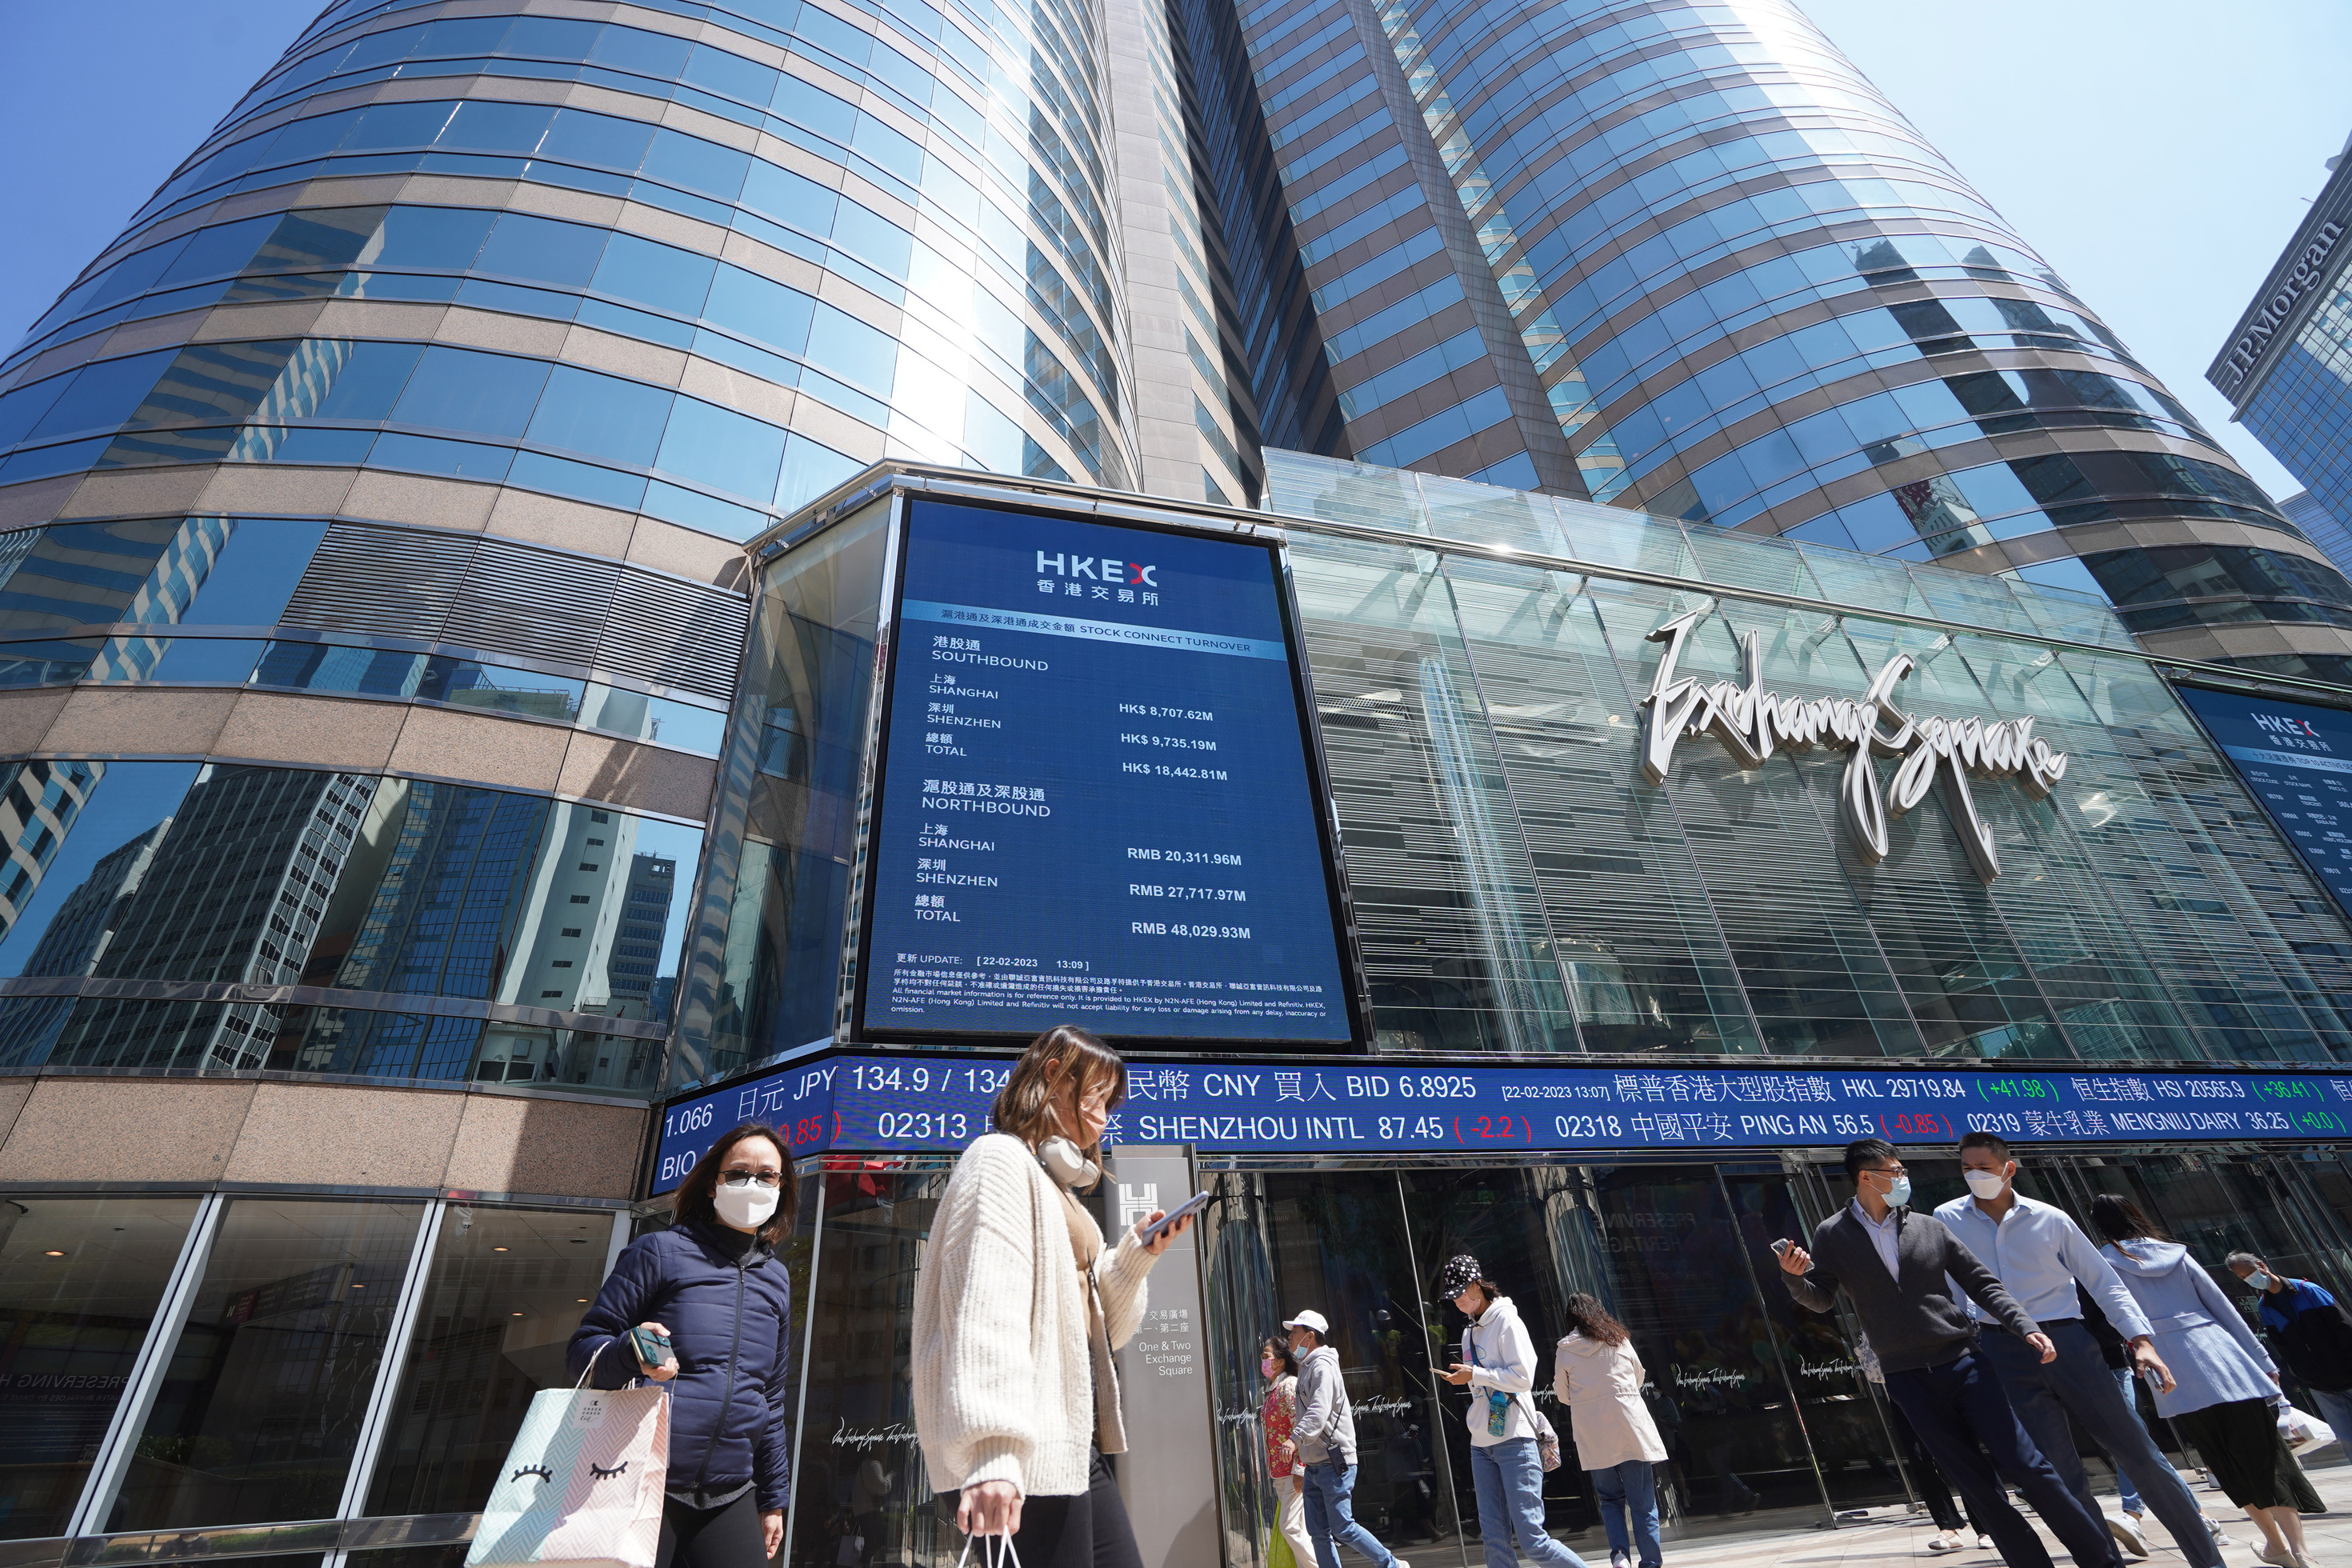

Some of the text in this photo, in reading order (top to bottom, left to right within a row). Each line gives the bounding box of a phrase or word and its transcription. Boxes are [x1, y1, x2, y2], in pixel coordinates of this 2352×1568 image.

[2226, 221, 2344, 386] J.P.Morgan
[1037, 550, 1158, 587] HKEX
[1037, 579, 1159, 606] 香港交易所
[932, 635, 981, 655] 港股通
[1080, 625, 1251, 653] STOCK CONNECT TURNOVER
[932, 650, 1049, 671] SOUTHBOUND
[930, 673, 957, 686] 上海
[929, 685, 998, 699] SHANGHAI
[927, 702, 954, 714] 深圳
[1119, 703, 1214, 722] HK$ 8,707.62M
[926, 714, 1001, 729] SHENZHEN
[2250, 713, 2321, 737] HKEX
[925, 731, 954, 745] 總額
[1121, 733, 1217, 751] HK$ 9,735.19M
[2269, 734, 2333, 752] 香港交易所
[925, 744, 967, 757] TOTAL
[1122, 762, 1228, 781] HK$ 18,442.81M
[922, 778, 1046, 805] 滬股通及深股通
[922, 794, 1050, 818] NORTHBOUND
[919, 822, 949, 836] 上海
[918, 837, 994, 851] SHANGHAI
[917, 858, 946, 872] 深圳
[1127, 847, 1242, 866] RMB 20,311.96M
[916, 872, 998, 887] SHENZHEN
[914, 894, 946, 908] 總額
[1130, 883, 1246, 902] RMB 27,717.97M
[914, 909, 961, 922] TOTAL
[1131, 922, 1251, 939] RMB 48,029.93M
[896, 953, 918, 963] 更新
[920, 954, 1083, 970] UPDATE: 22-02-2023 13:09
[793, 1066, 838, 1101] JPY
[852, 1066, 930, 1092] 134.9
[1126, 1069, 1190, 1102] 民幣
[1203, 1073, 1261, 1097] CNY
[1274, 1071, 1337, 1102] 買入
[1346, 1075, 1477, 1098] BID 6.8925
[1612, 1074, 1837, 1103] 標普香港大型股指數
[1841, 1078, 2046, 1098] HKL 29719.84 +41.98
[2070, 1077, 2156, 1102] 恒生指數
[2153, 1080, 2311, 1098] HSI 20565.9 +36.41
[2330, 1079, 2352, 1102] 恒
[737, 1079, 785, 1122] 日元
[878, 1112, 967, 1139] 02313
[1139, 1115, 1298, 1140] SHENZHOU
[1306, 1117, 1365, 1139] INTL
[1378, 1116, 1444, 1139] 87.45
[1470, 1115, 1514, 1138] -2.2
[1555, 1115, 1622, 1138] 02318
[1630, 1111, 1734, 1142] 中國平安
[1739, 1114, 1939, 1135] PING AN 56.5 -0.85
[1966, 1113, 2021, 1133] 02319
[2021, 1110, 2111, 1137] 蒙牛乳業
[2110, 1111, 2334, 1131] MENGNIU DAIRY 36.25 +0.0
[661, 1115, 822, 1181] BIO 0.85
[1138, 1340, 1191, 1352] One & Two
[1146, 1354, 1192, 1365] Exchange
[1158, 1366, 1193, 1378] Square
